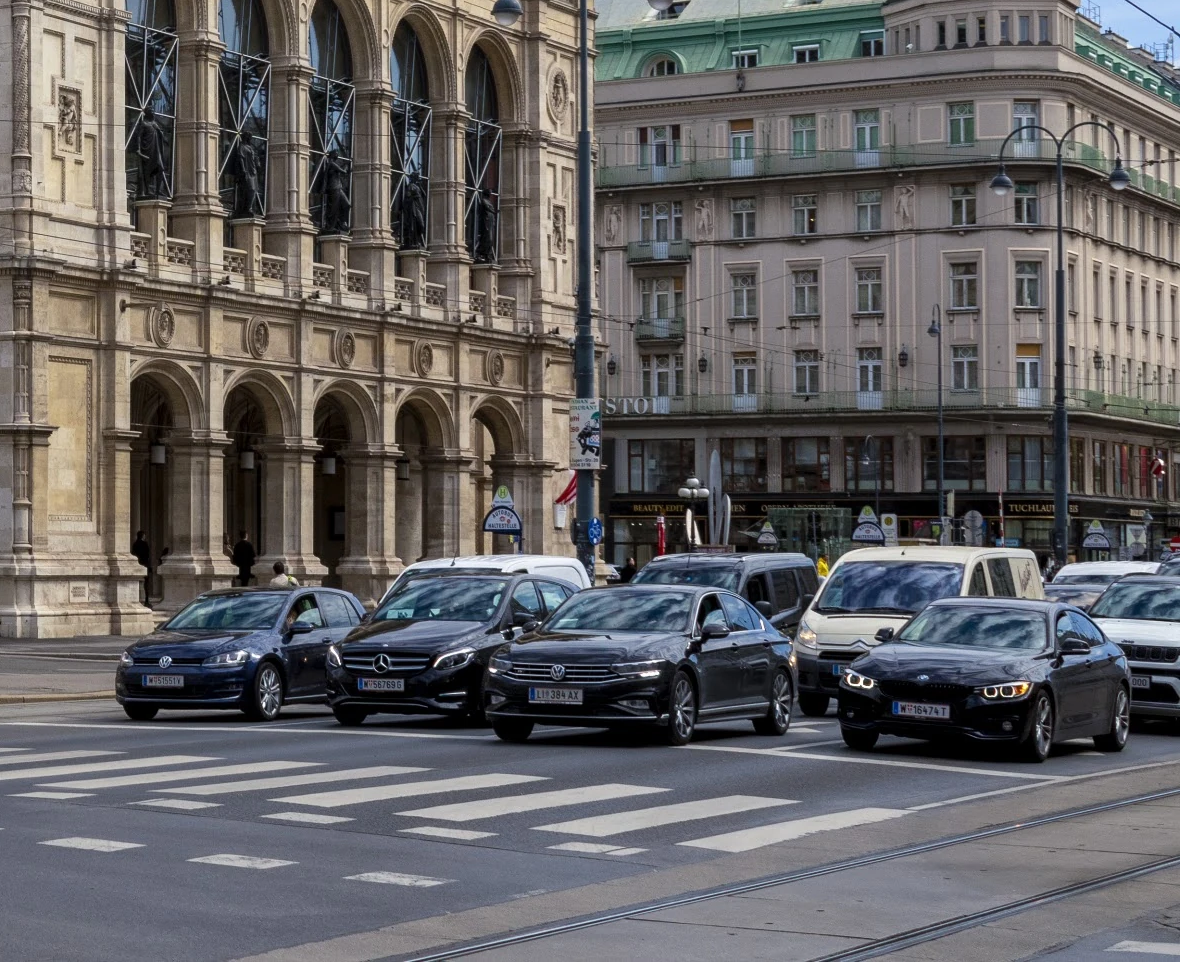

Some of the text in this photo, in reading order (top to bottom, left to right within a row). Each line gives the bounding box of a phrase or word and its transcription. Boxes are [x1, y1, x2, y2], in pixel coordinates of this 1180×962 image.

[633, 504, 684, 512] BEAUTY EDIT
[1008, 504, 1055, 512] TUCHLAU
[492, 510, 514, 519] AUTOBUS
[550, 690, 566, 699] 384
